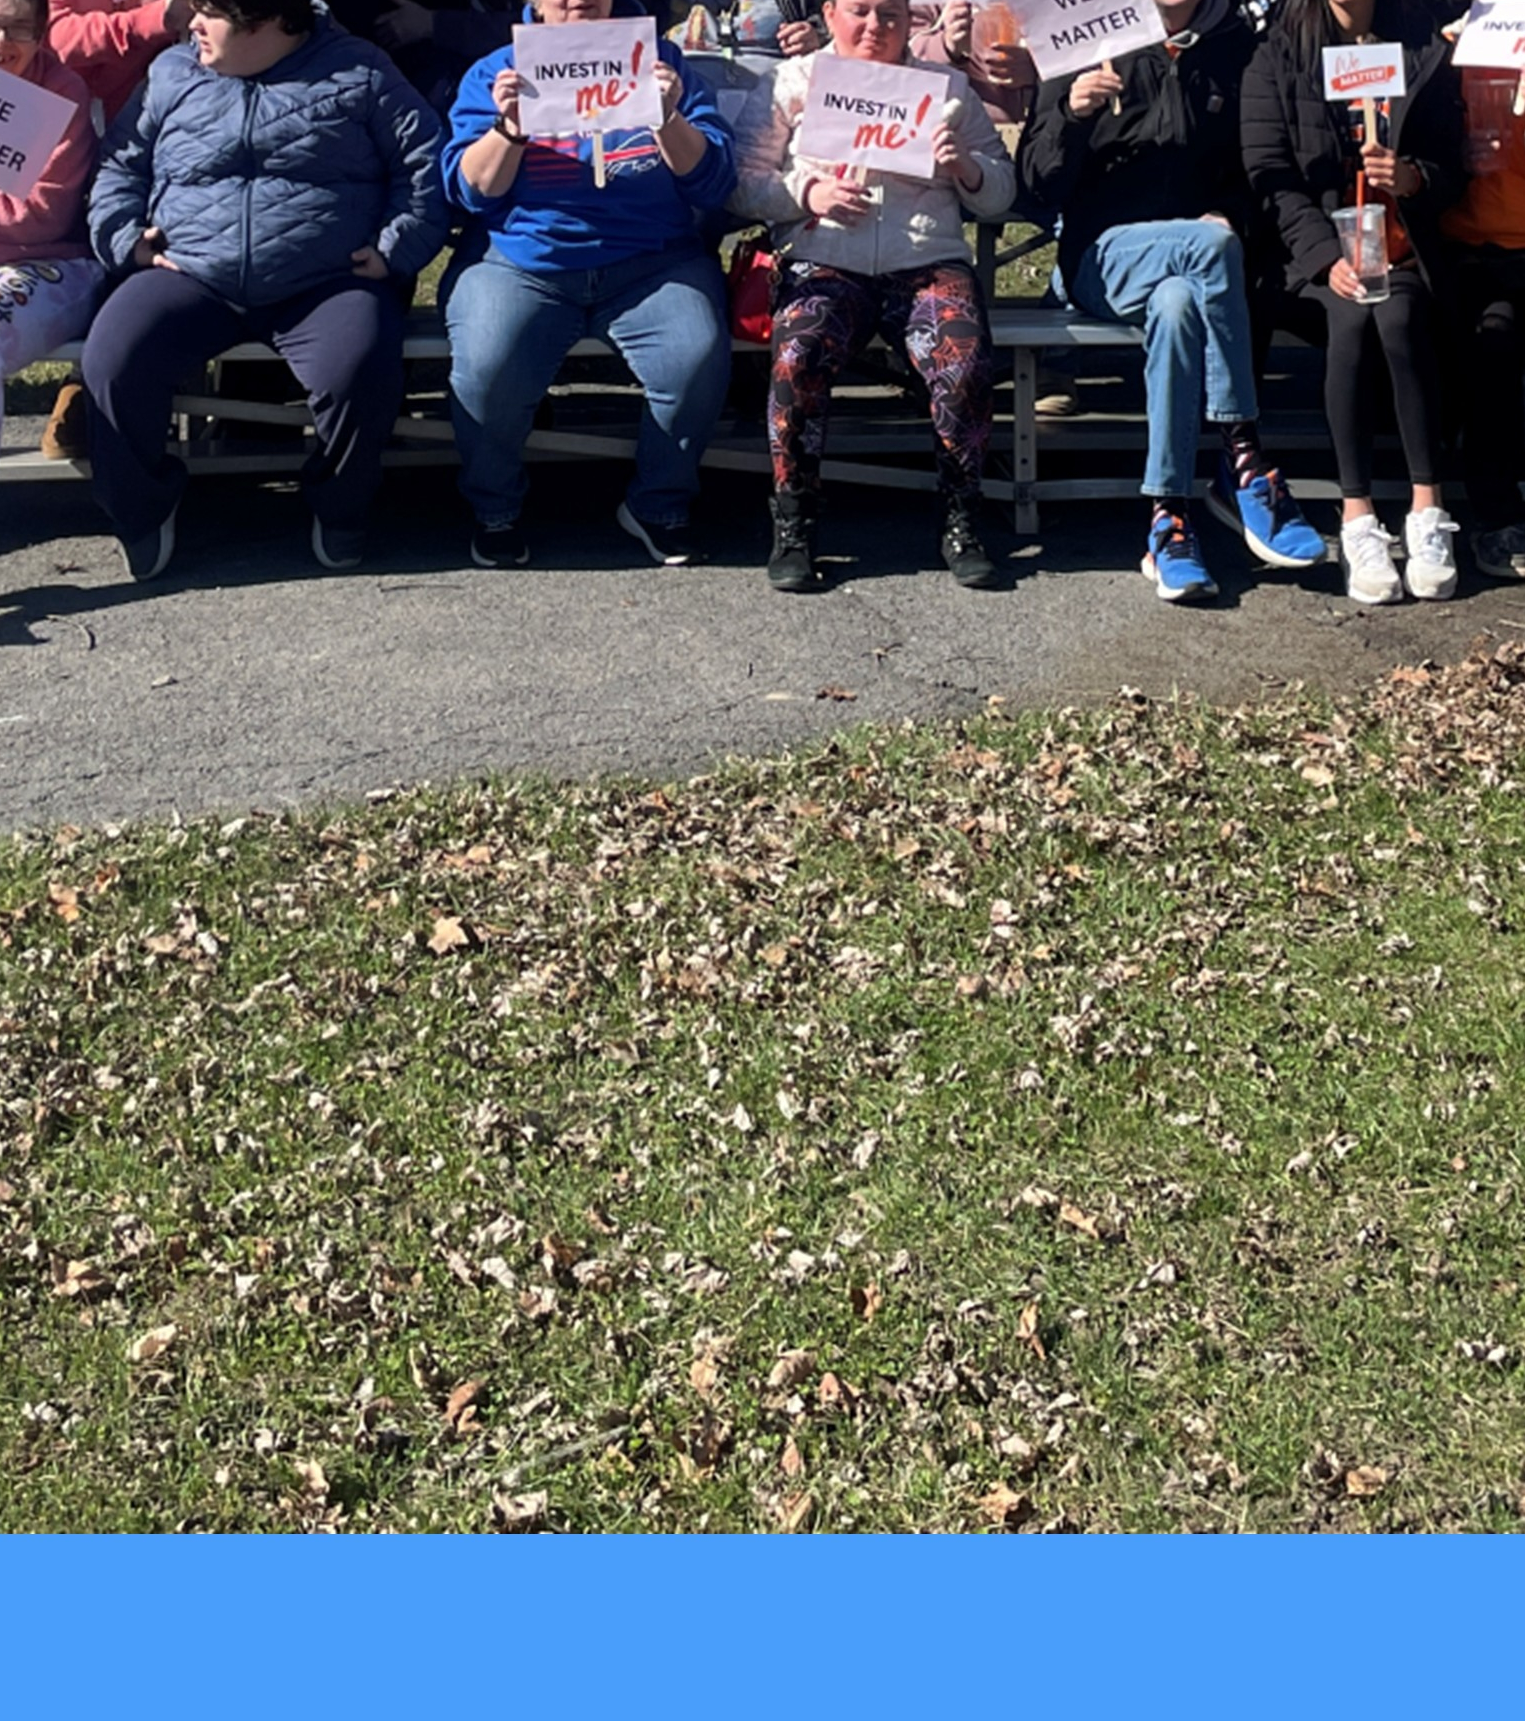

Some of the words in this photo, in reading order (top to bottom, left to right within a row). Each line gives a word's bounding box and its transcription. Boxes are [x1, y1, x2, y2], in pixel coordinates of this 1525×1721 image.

[1050, 6, 1141, 51] MATTER
[535, 60, 599, 80] INVEST
[603, 60, 623, 76] IN
[576, 40, 644, 115] me!
[823, 93, 887, 117] INVEST
[888, 106, 907, 121] IN
[852, 93, 932, 150] me!
